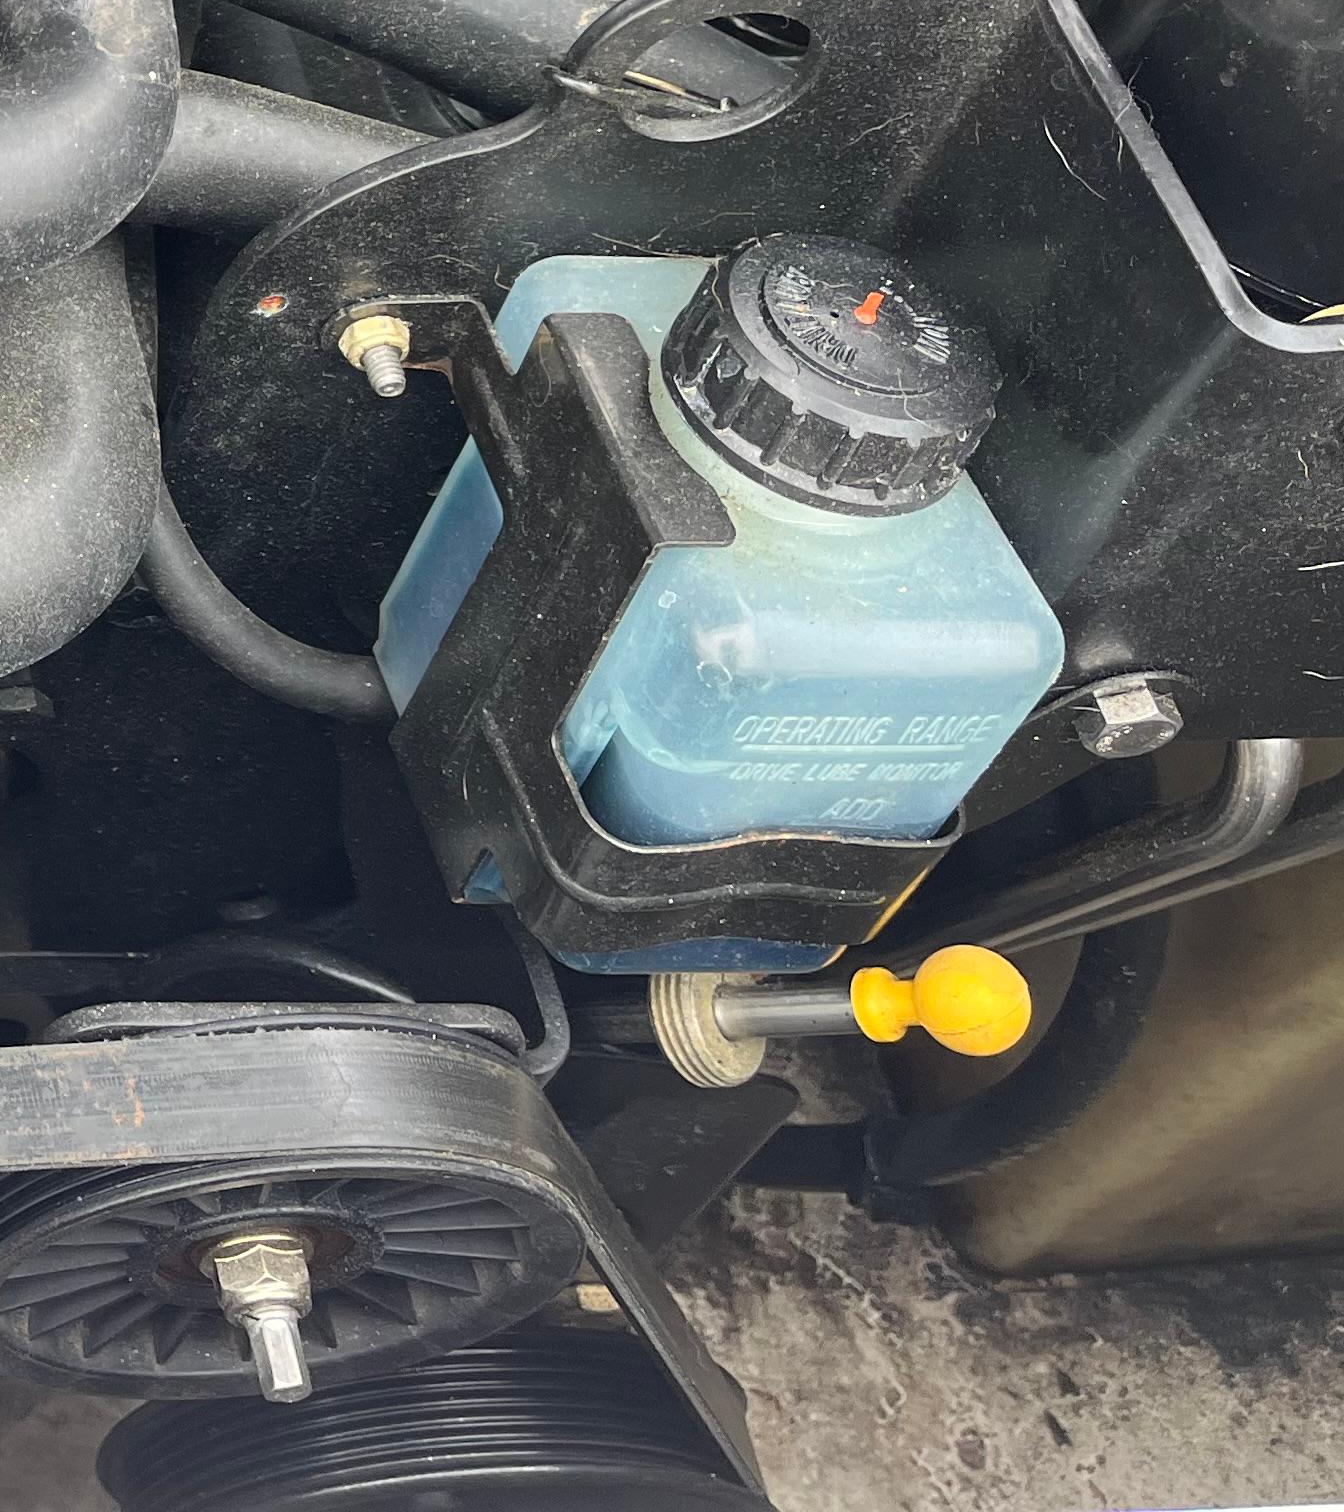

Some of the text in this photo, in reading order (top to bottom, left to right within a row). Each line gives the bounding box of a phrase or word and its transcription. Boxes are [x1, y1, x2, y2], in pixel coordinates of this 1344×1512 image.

[734, 714, 1002, 744] OPERATING RANGE
[730, 762, 962, 781] DRIVE LUBE MONITOR
[819, 798, 886, 820] ADD
